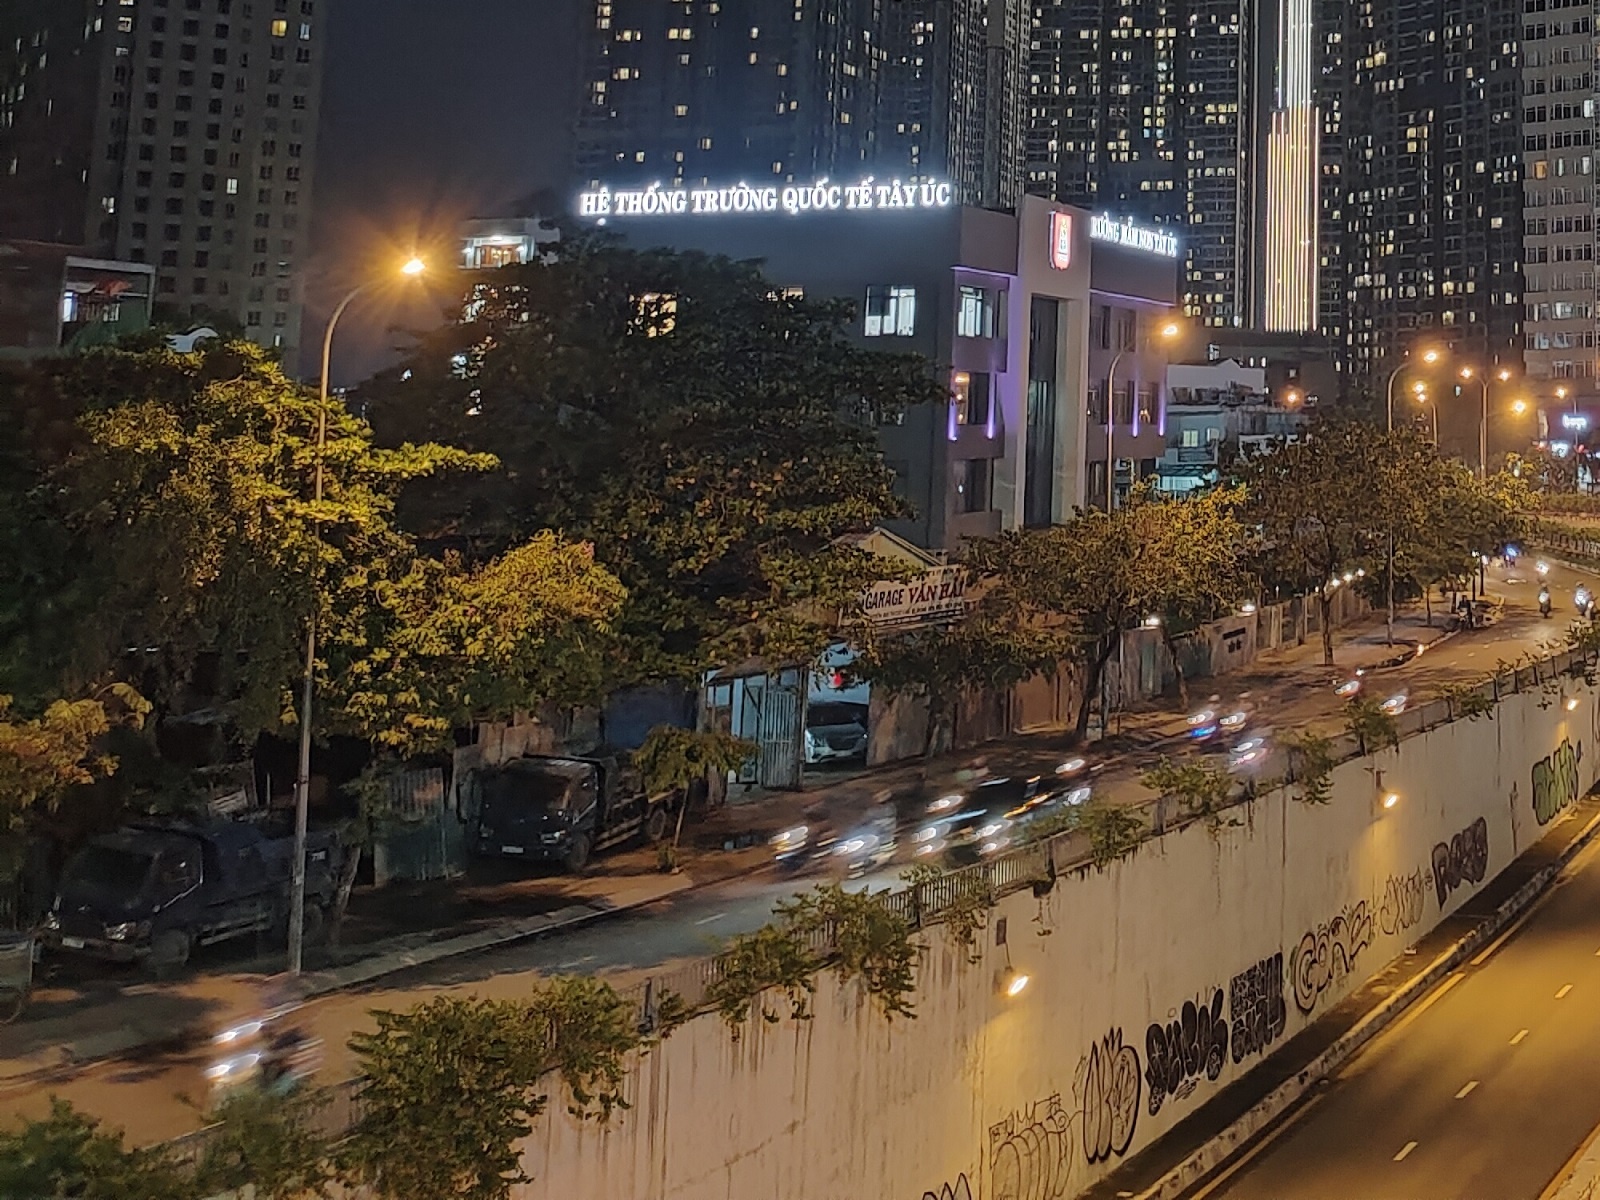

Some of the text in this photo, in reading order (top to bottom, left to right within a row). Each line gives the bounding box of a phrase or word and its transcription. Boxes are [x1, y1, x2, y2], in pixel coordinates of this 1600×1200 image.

[580, 175, 950, 226] HỆ THỐNG TRƯỜNG QUỐC TẾ TÂY ÚC
[865, 588, 904, 609] GARAGE
